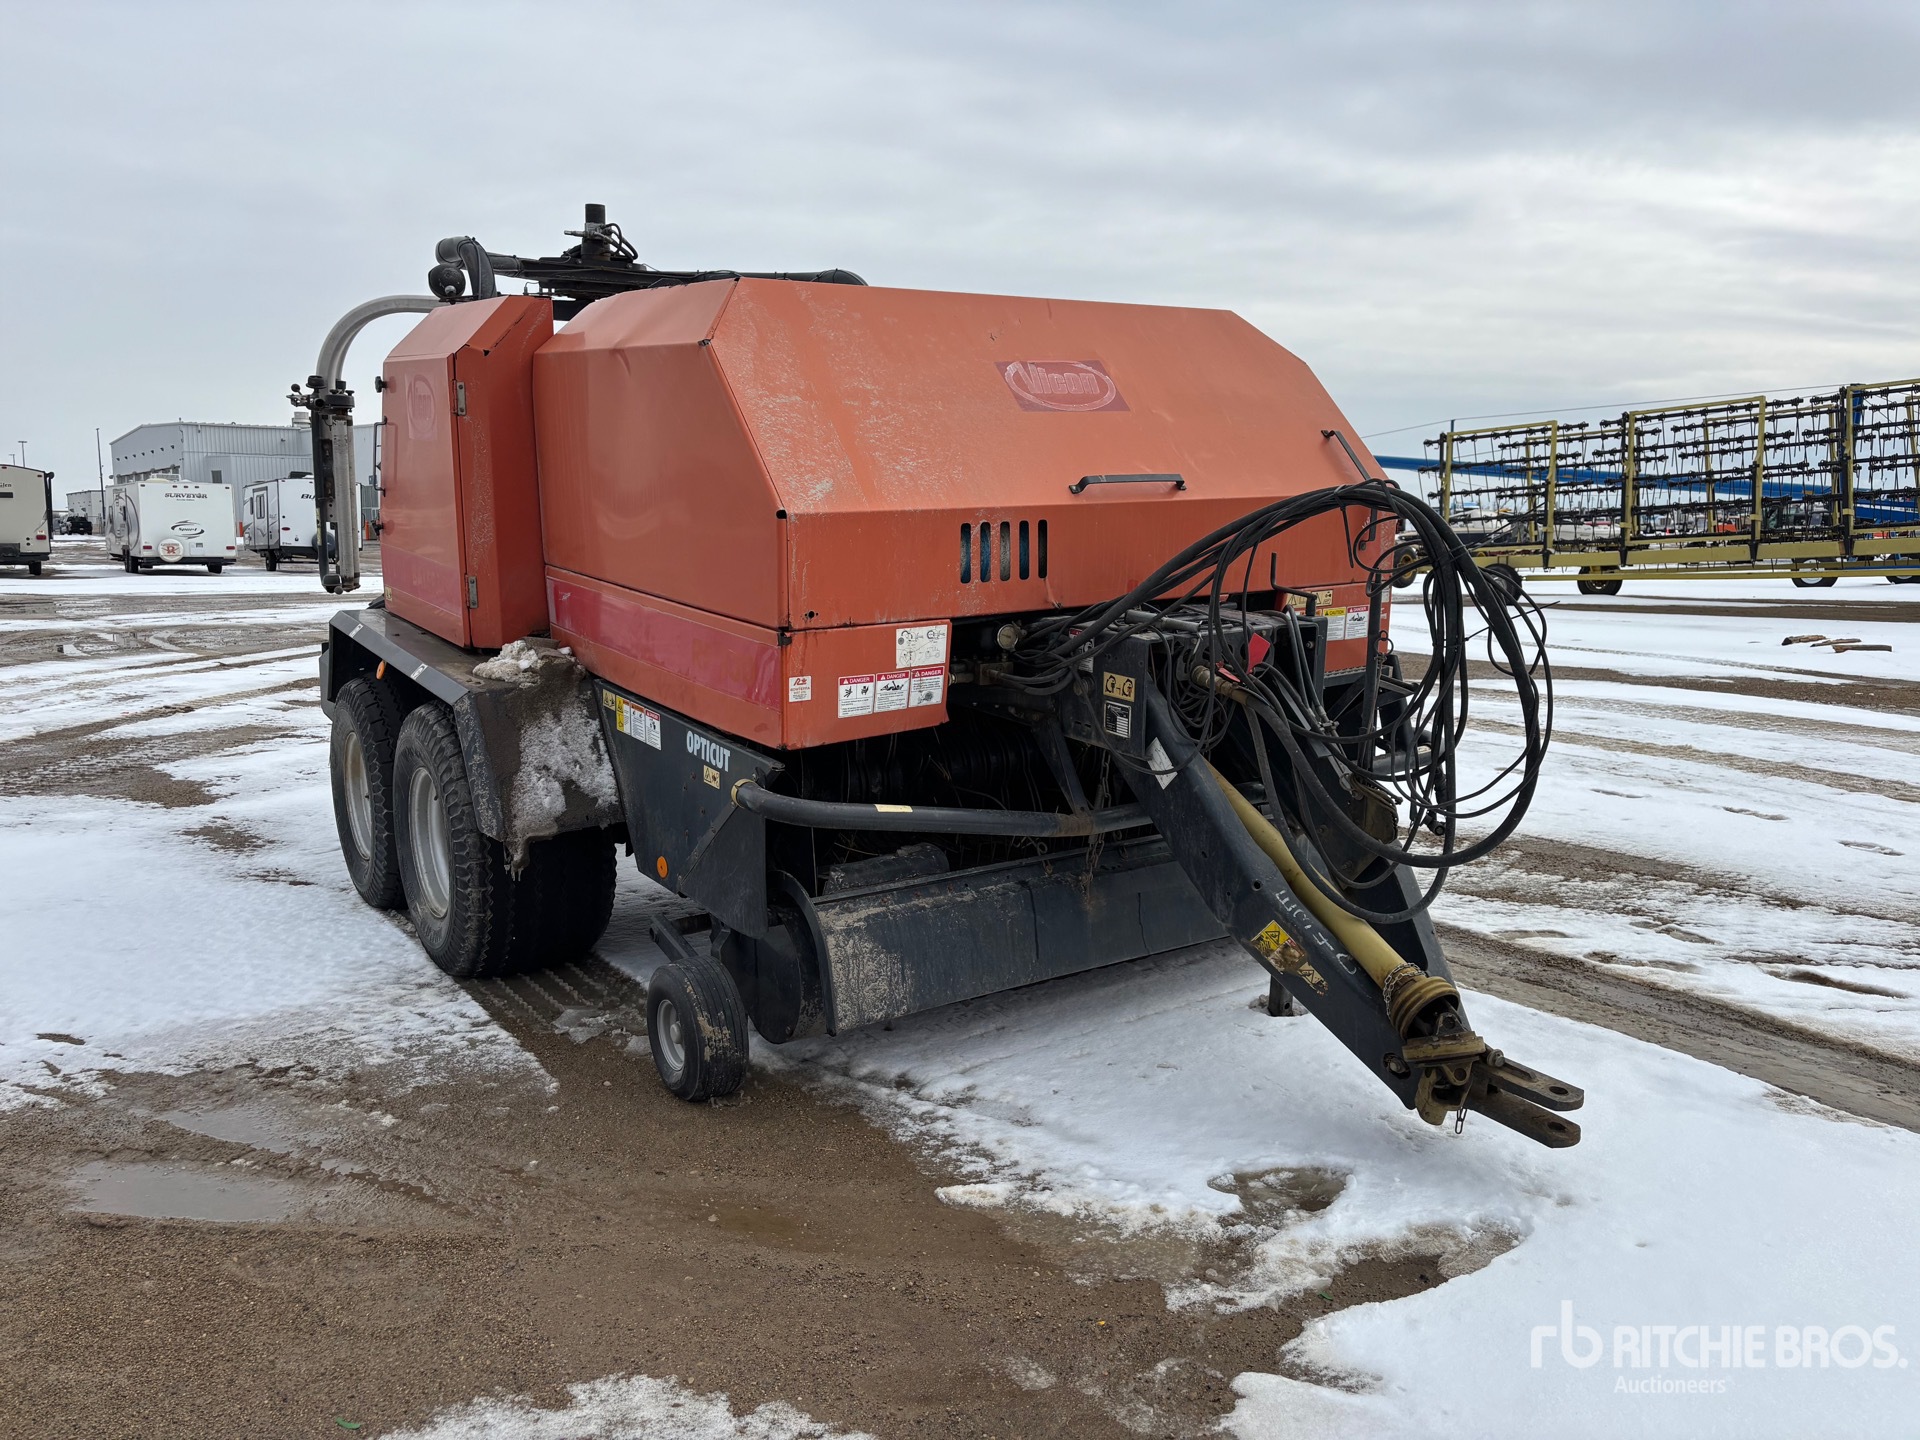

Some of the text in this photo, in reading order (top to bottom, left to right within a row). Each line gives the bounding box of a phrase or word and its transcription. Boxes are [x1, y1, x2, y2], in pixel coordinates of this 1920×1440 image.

[1011, 361, 1100, 394] Vicon
[886, 672, 906, 680] DANGER
[921, 669, 942, 677] DANGER
[849, 676, 870, 684] DANGER
[686, 730, 731, 772] OPTICUT
